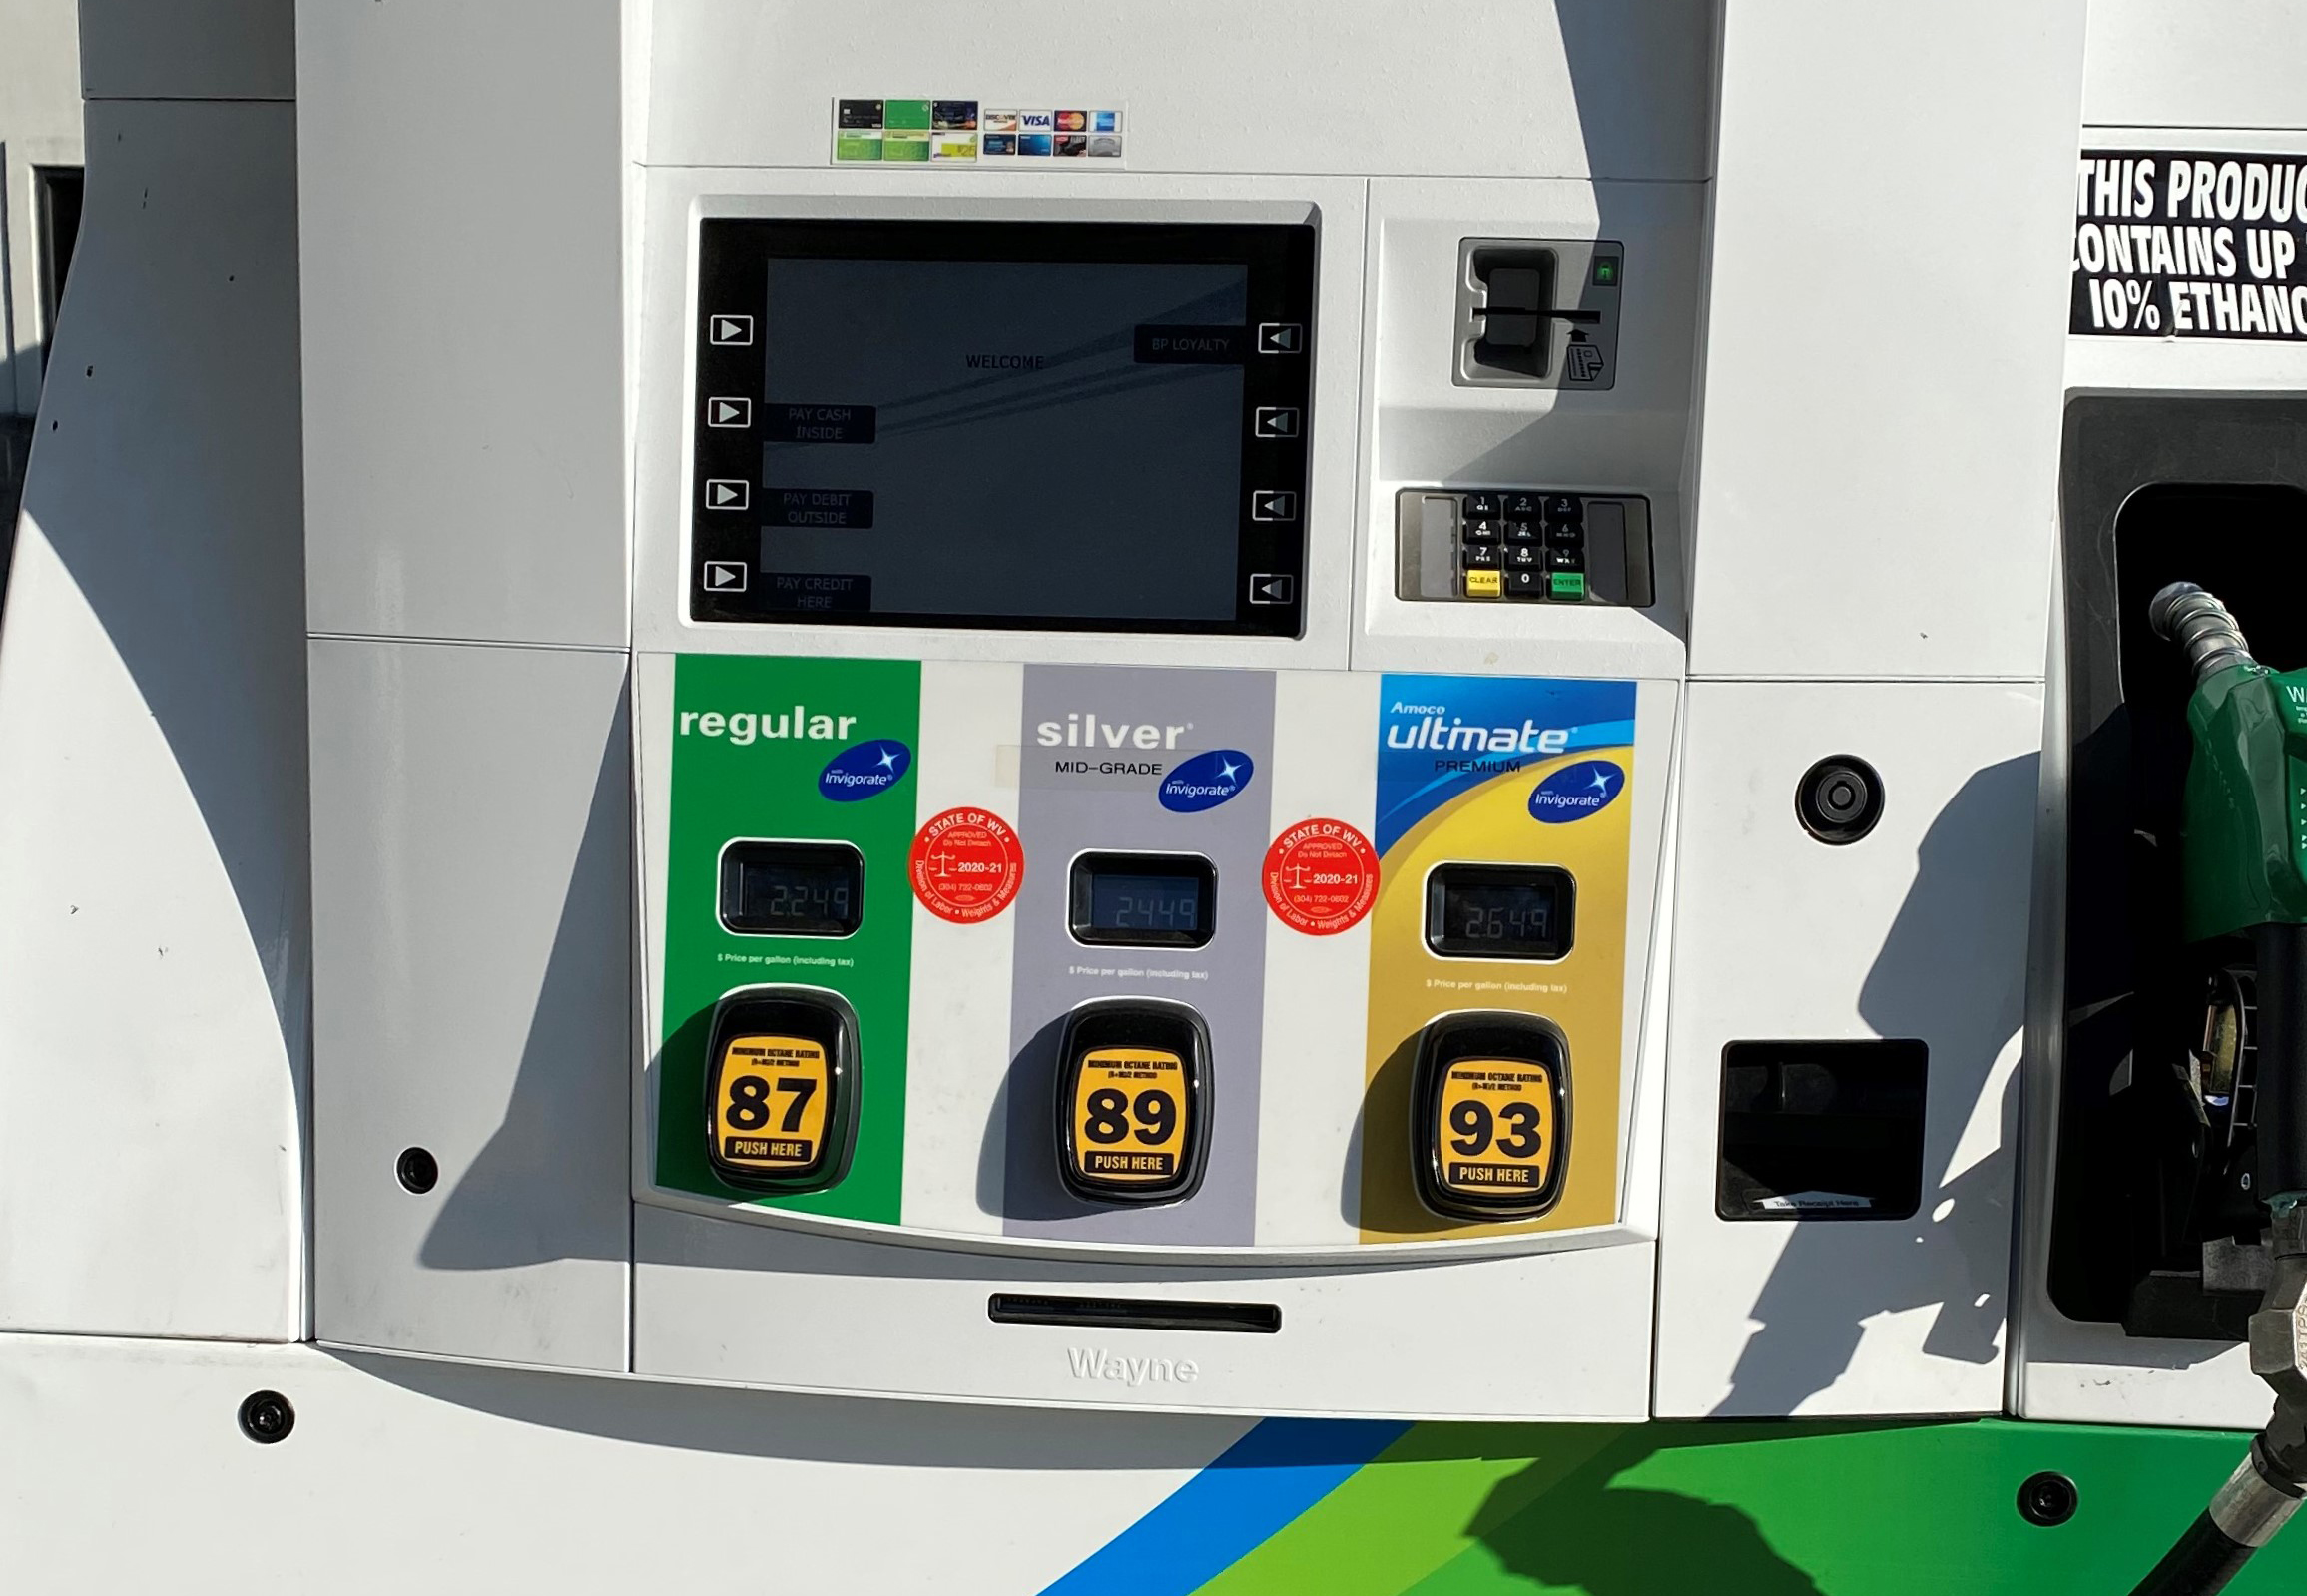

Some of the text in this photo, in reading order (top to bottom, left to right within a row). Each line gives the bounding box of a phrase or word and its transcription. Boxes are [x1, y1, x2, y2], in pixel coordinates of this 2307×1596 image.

[1022, 115, 1050, 126] VISA
[2078, 159, 2155, 218] THIS
[2246, 229, 2296, 279] UP
[2088, 278, 2160, 331] 10%
[1152, 337, 1230, 352] BP LOYALTY
[966, 354, 1045, 371] WELCOME
[788, 407, 852, 422] PAY CASH
[795, 426, 844, 440] INSIDE
[783, 493, 852, 507] PAY DEBIT
[1480, 496, 1485, 505] 1
[1519, 497, 1527, 506] 2
[1561, 498, 1568, 507] 3
[787, 511, 847, 525] OUTSIDE
[1478, 521, 1487, 530] 4
[1520, 522, 1527, 531] 5
[1479, 547, 1487, 556] 7
[1520, 548, 1529, 557] 8
[776, 576, 854, 591] PAY CREDIT
[1521, 574, 1530, 583] 0
[797, 595, 834, 609] HERE
[1391, 701, 1445, 715] Amoco
[680, 706, 857, 746] regular
[1037, 713, 1186, 750] silver
[1387, 716, 1569, 755] ultimate
[1055, 761, 1163, 776] MID-GRADE
[1434, 760, 1521, 774] PREMIUM
[928, 812, 1007, 837] STATE OF WV
[1283, 823, 1363, 848] STATE OF WV
[957, 862, 1002, 873] 2020-21
[1313, 873, 1358, 884] 2020-21
[748, 955, 763, 964] per
[793, 956, 836, 967] (including
[837, 958, 854, 967] tax)
[1077, 966, 1099, 975] Price
[1117, 968, 1144, 977] gallon
[1146, 969, 1189, 980] (including
[1191, 971, 1208, 980] tax)
[1434, 979, 1455, 988] Price
[1457, 980, 1472, 989] per
[1475, 981, 1501, 990] gallon
[1504, 981, 1548, 993] (including
[1550, 983, 1567, 993] tax)
[726, 1075, 818, 1133] 87
[1084, 1088, 1177, 1145] 89
[1449, 1099, 1542, 1158] 93
[734, 1141, 803, 1156] PUSH HERE
[1095, 1155, 1163, 1170] PUSH HERE
[1459, 1166, 1529, 1183] PUSH HERE
[1067, 1347, 1199, 1387] Wayne
